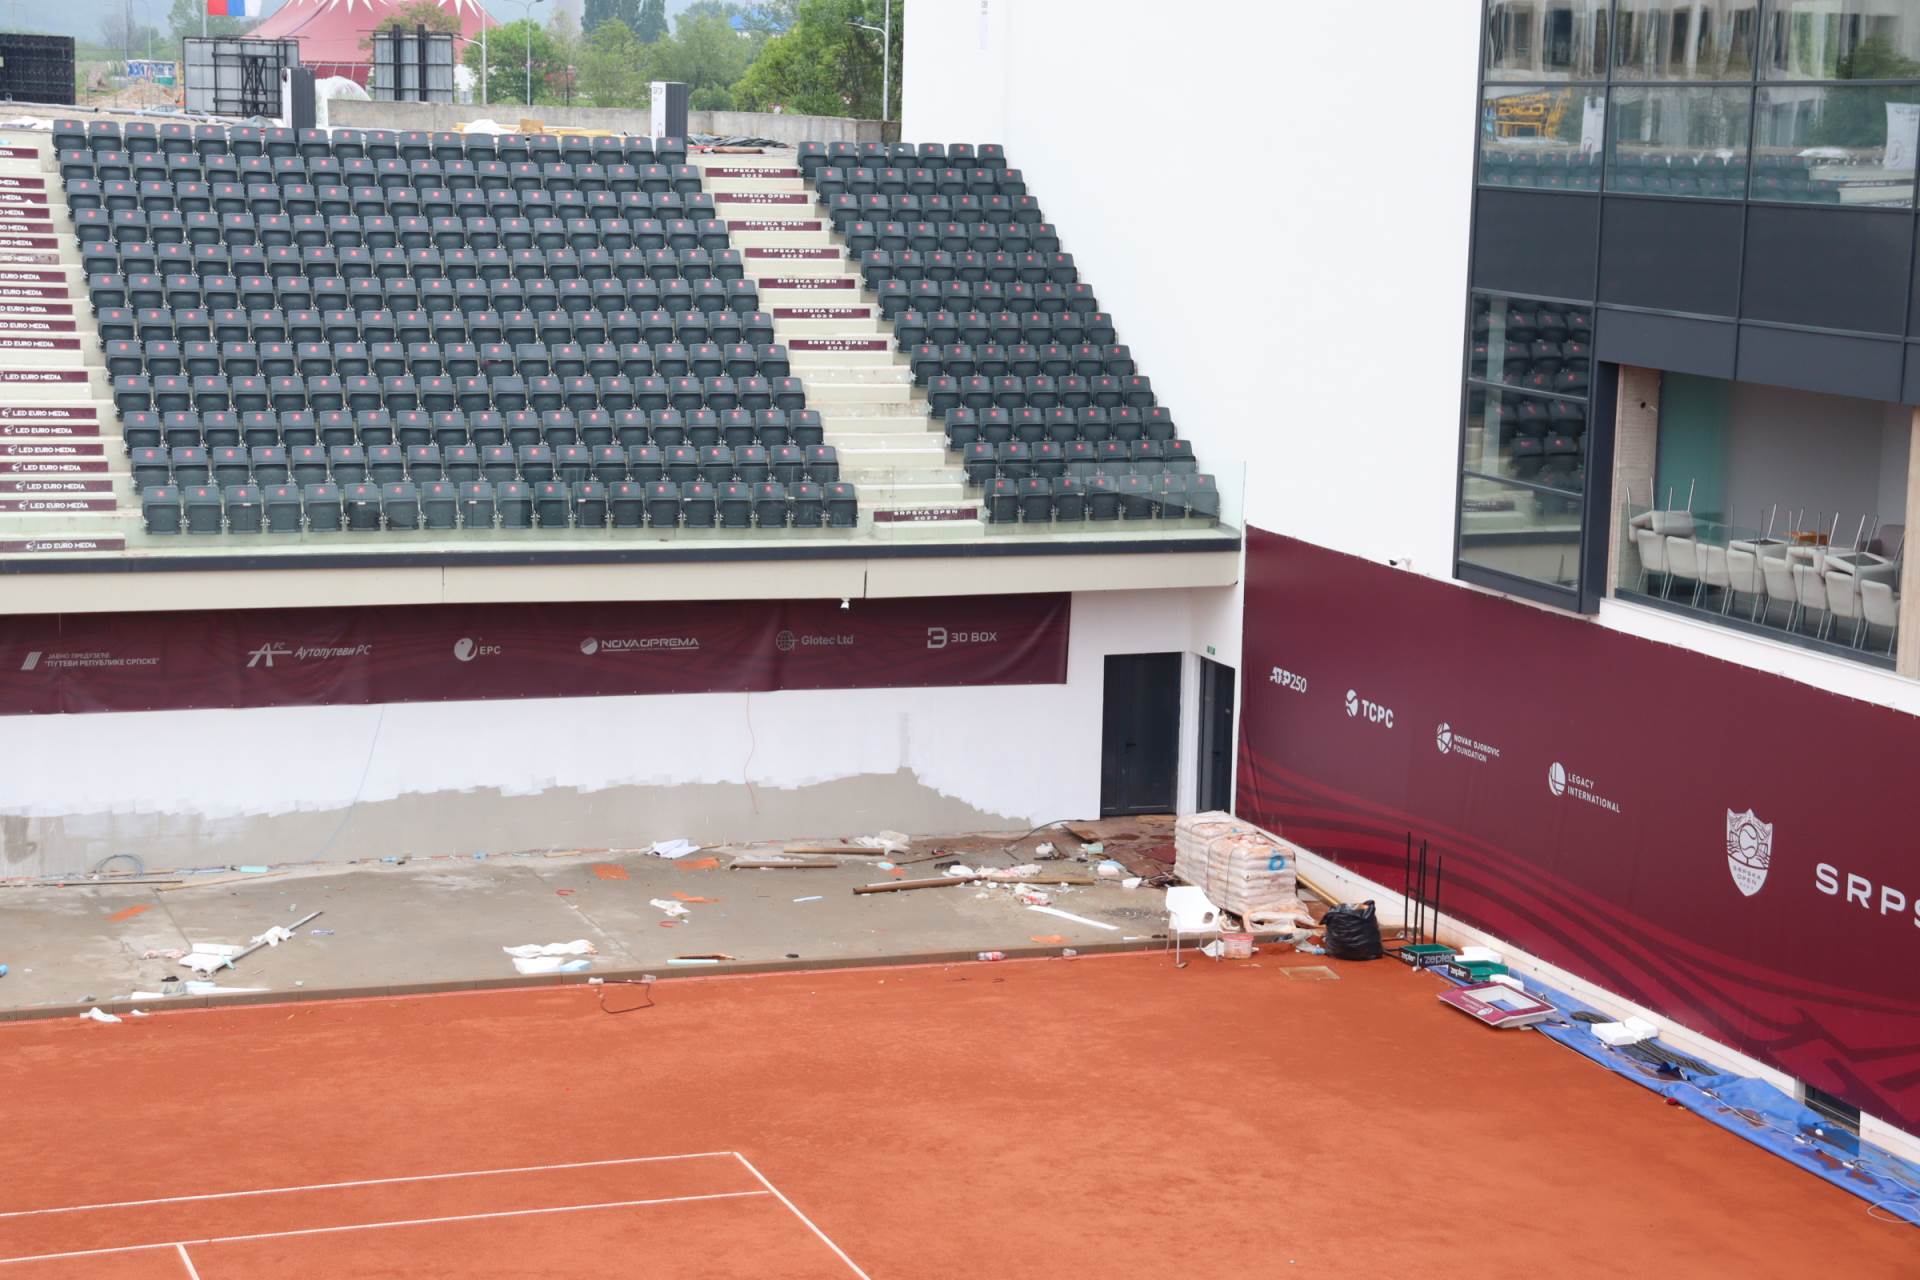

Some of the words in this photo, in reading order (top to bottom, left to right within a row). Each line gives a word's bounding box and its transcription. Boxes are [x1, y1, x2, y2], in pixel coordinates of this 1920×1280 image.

[74, 541, 97, 549] MEDIA
[601, 638, 700, 650] NOVAOPREMA
[837, 633, 854, 645] Ltd
[951, 632, 968, 642] 3D
[971, 631, 998, 642] BOX
[1361, 699, 1394, 729] TCPC
[1454, 734, 1473, 747] NOVAK
[1453, 744, 1488, 763] FOUNDATION
[1568, 772, 1594, 789] LEGACY
[1567, 785, 1621, 814] INTERNATIONAL
[1815, 862, 1920, 928] SRP
